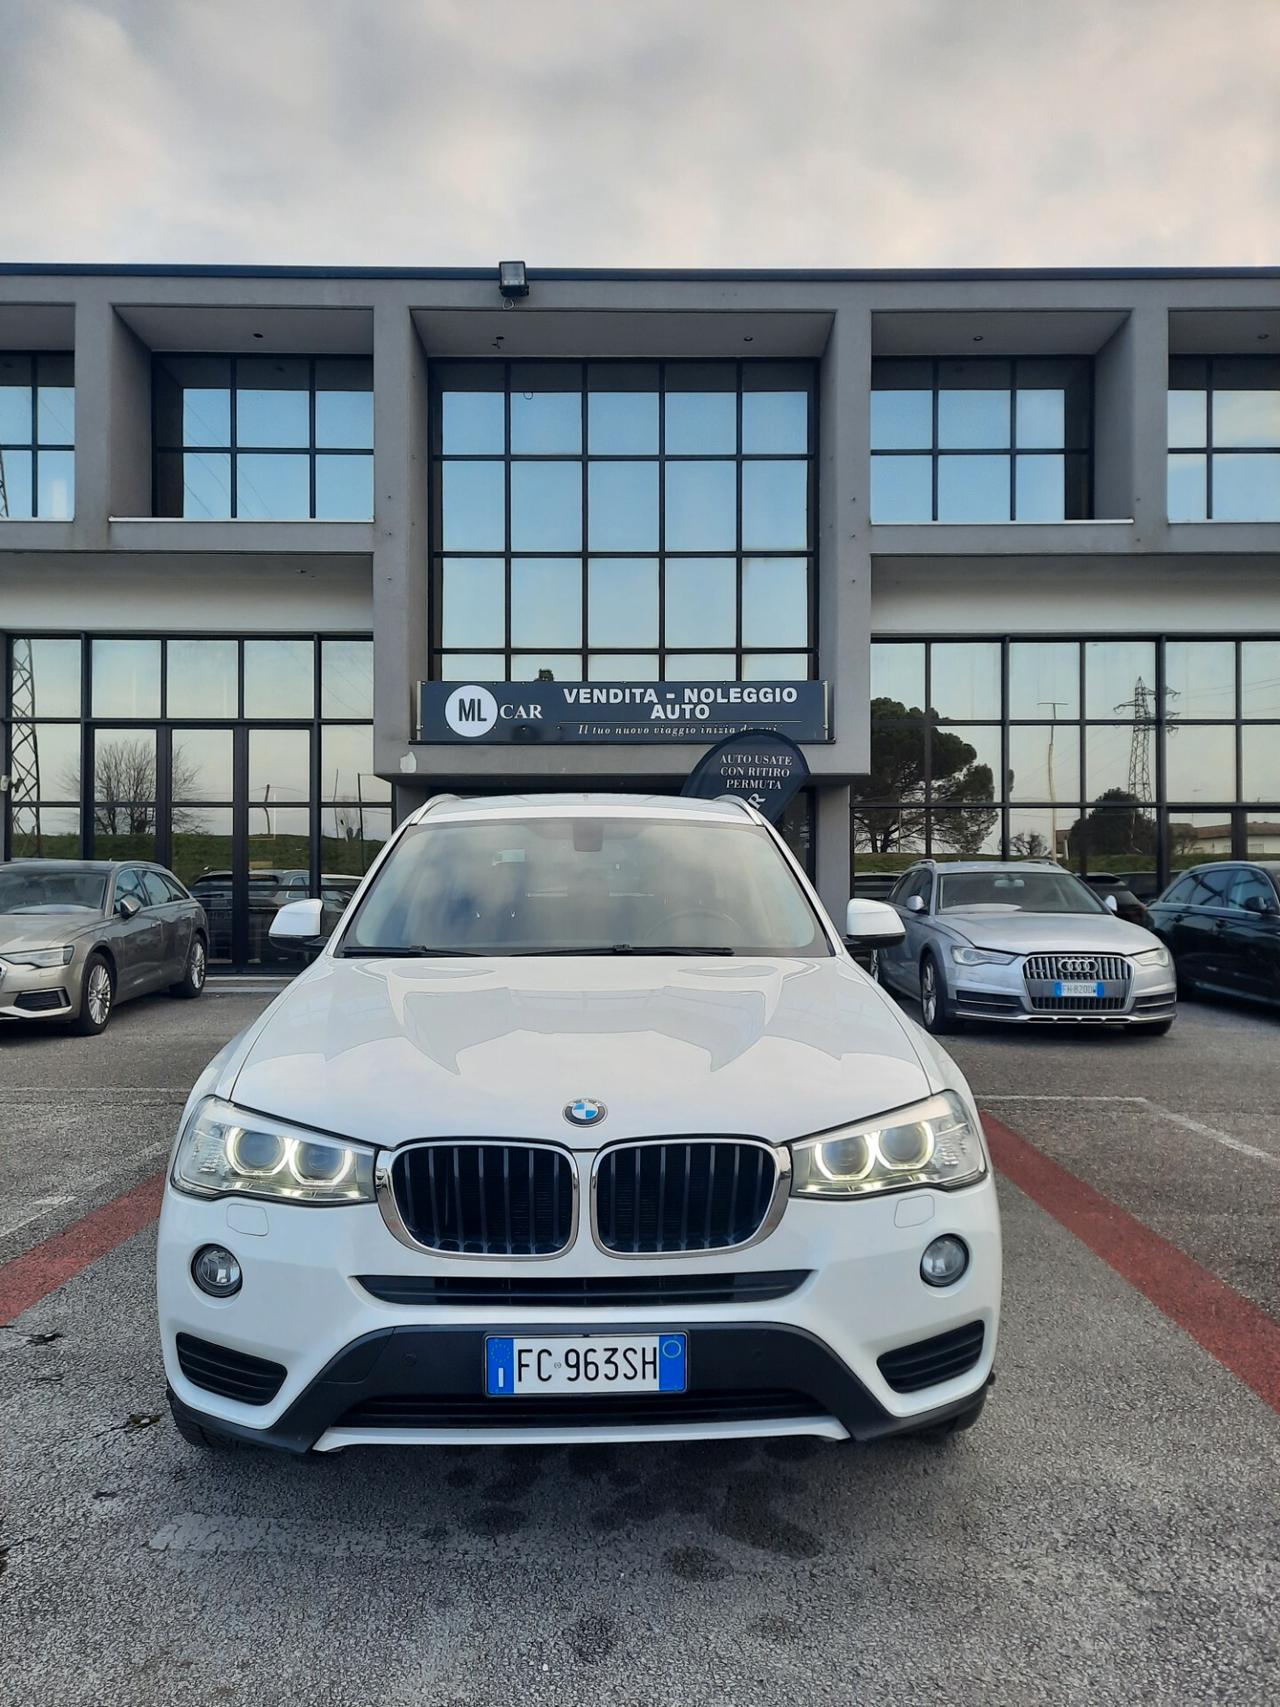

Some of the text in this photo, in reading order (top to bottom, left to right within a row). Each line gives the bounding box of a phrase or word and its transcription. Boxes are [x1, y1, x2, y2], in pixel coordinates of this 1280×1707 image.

[563, 688, 658, 703] VENDITA
[684, 688, 798, 703] NOLEGGIO
[458, 698, 487, 722] ML
[499, 704, 543, 719] CAR
[650, 704, 710, 719] AUTO
[578, 724, 589, 735] Il
[592, 725, 611, 734] tuo
[615, 727, 650, 735] nuovo
[653, 724, 697, 737] viaggio
[701, 724, 736, 735] inizia
[720, 754, 792, 766] AUTO USATE
[720, 766, 790, 778] CON RITIRO
[726, 779, 782, 790] PERMUTA
[517, 1348, 553, 1382] FC
[564, 1346, 658, 1382] 963SH
